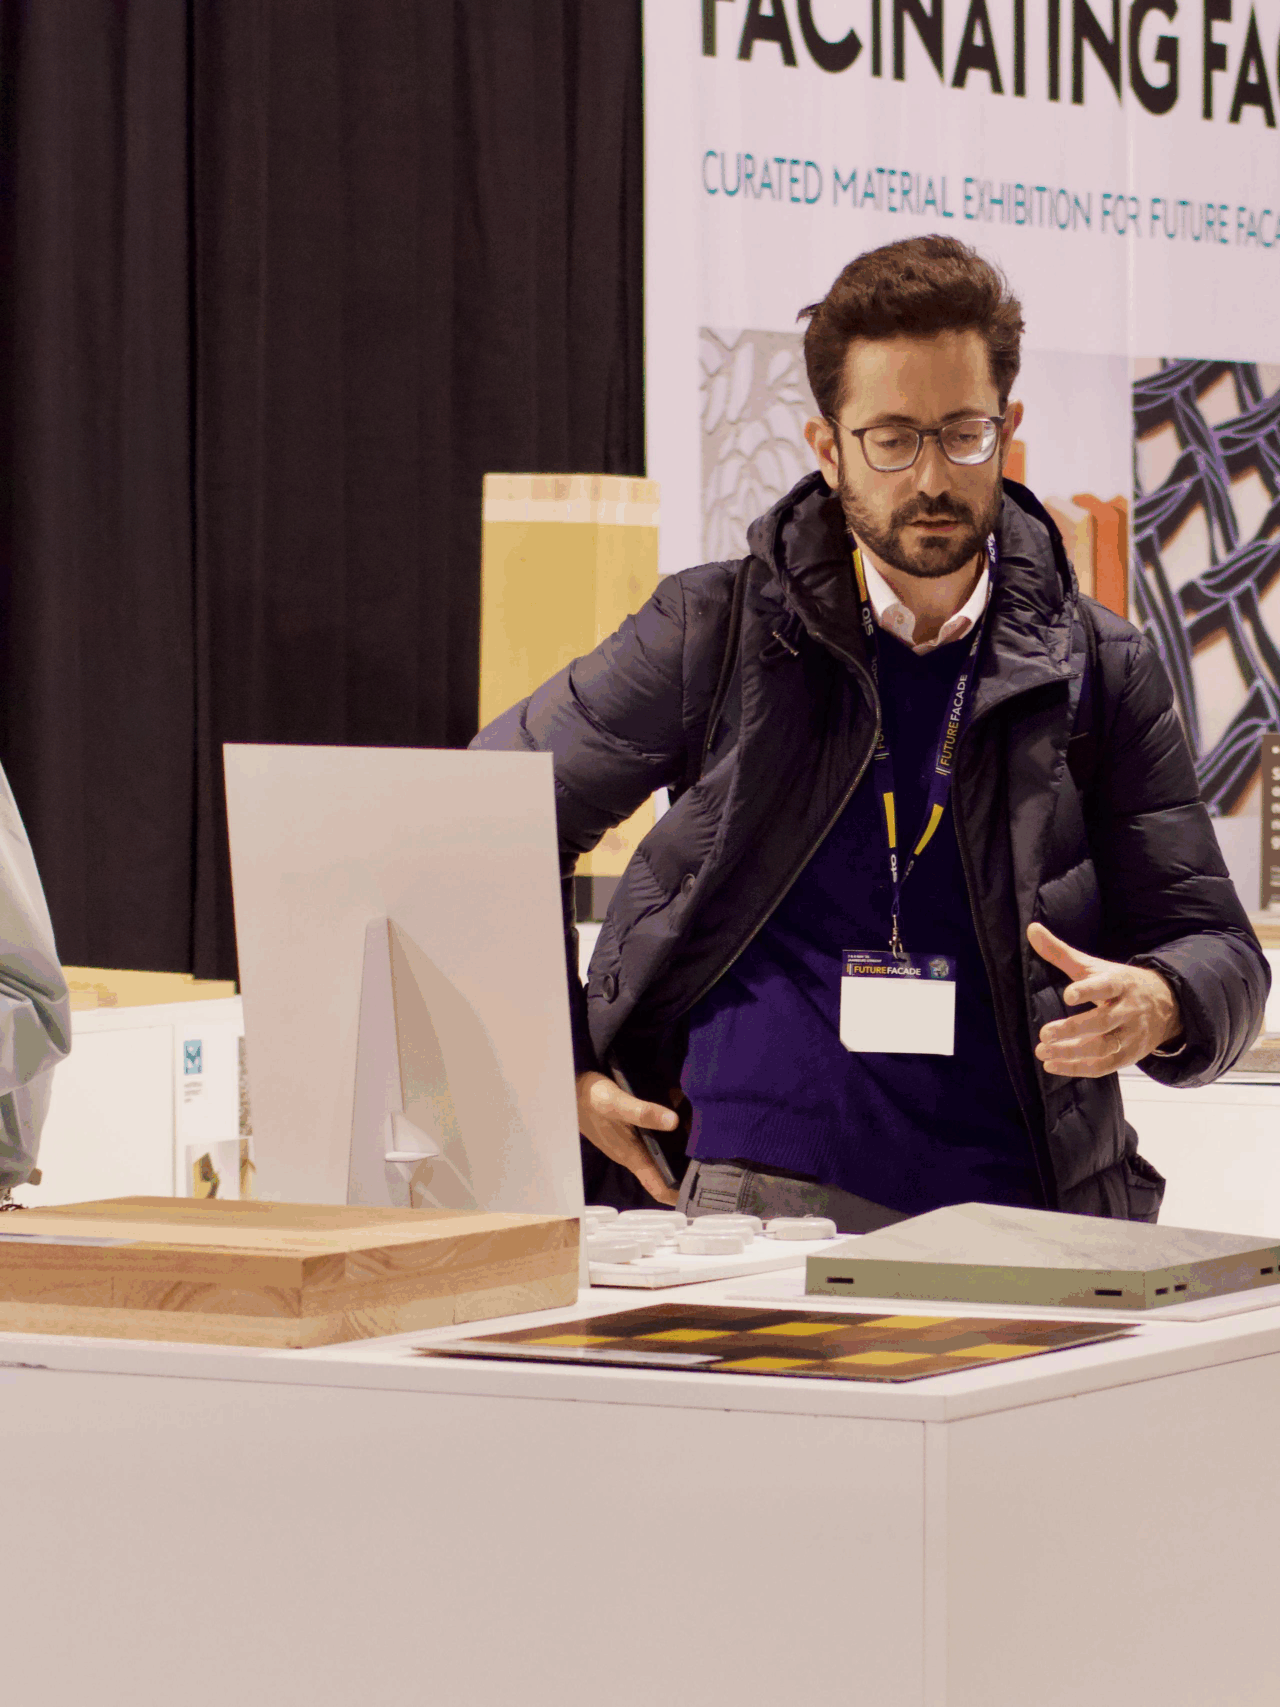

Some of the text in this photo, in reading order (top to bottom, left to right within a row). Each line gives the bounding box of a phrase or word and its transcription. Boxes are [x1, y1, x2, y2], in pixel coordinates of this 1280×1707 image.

[702, 150, 823, 205] CURATED
[833, 167, 954, 217] MATERIAL
[964, 177, 1093, 230] EXHIBITION
[1101, 192, 1142, 237] FOR
[1150, 197, 1230, 245] FUTURE
[939, 674, 968, 766] FUTUREFACADE
[853, 965, 922, 976] FUTUREFACADE
